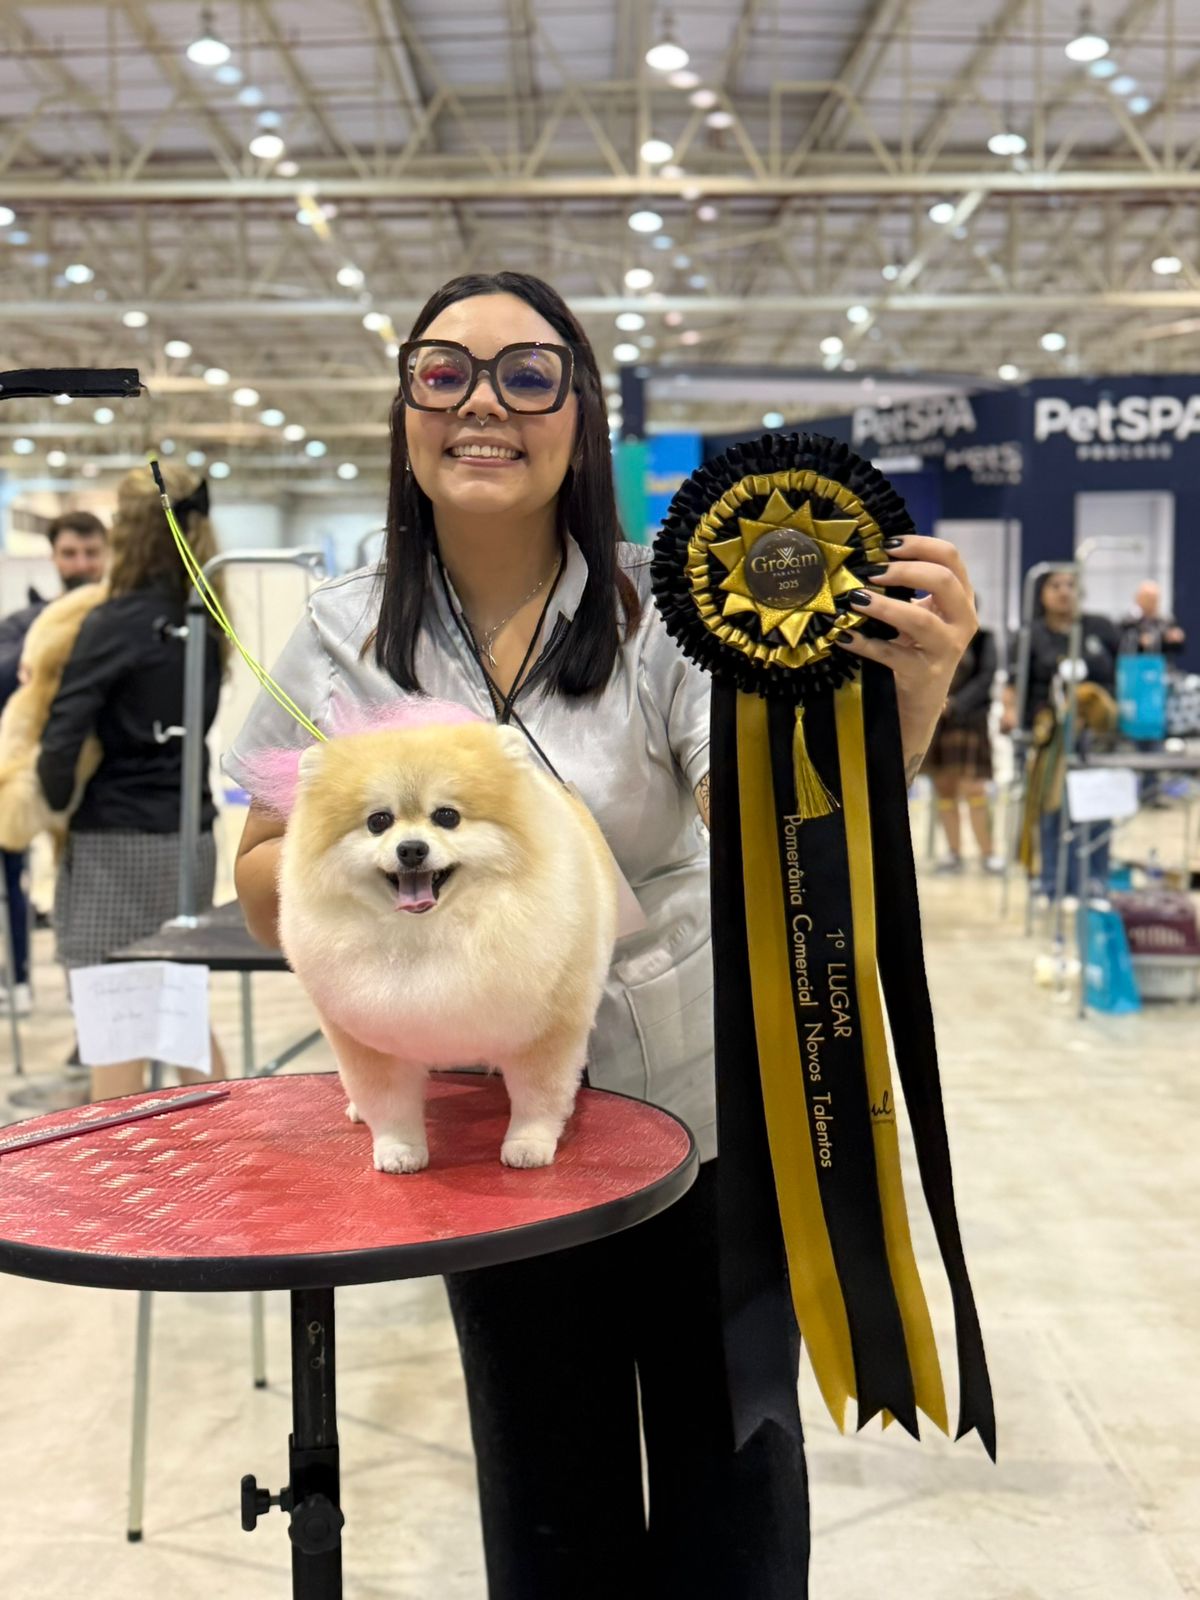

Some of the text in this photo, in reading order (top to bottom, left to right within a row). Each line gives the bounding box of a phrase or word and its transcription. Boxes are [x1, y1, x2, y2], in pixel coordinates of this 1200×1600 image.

[778, 579, 799, 590] 2025
[783, 815, 834, 1168] Pomerânia Comercial Novos Talentos
[827, 963, 852, 1038] LUGAR
